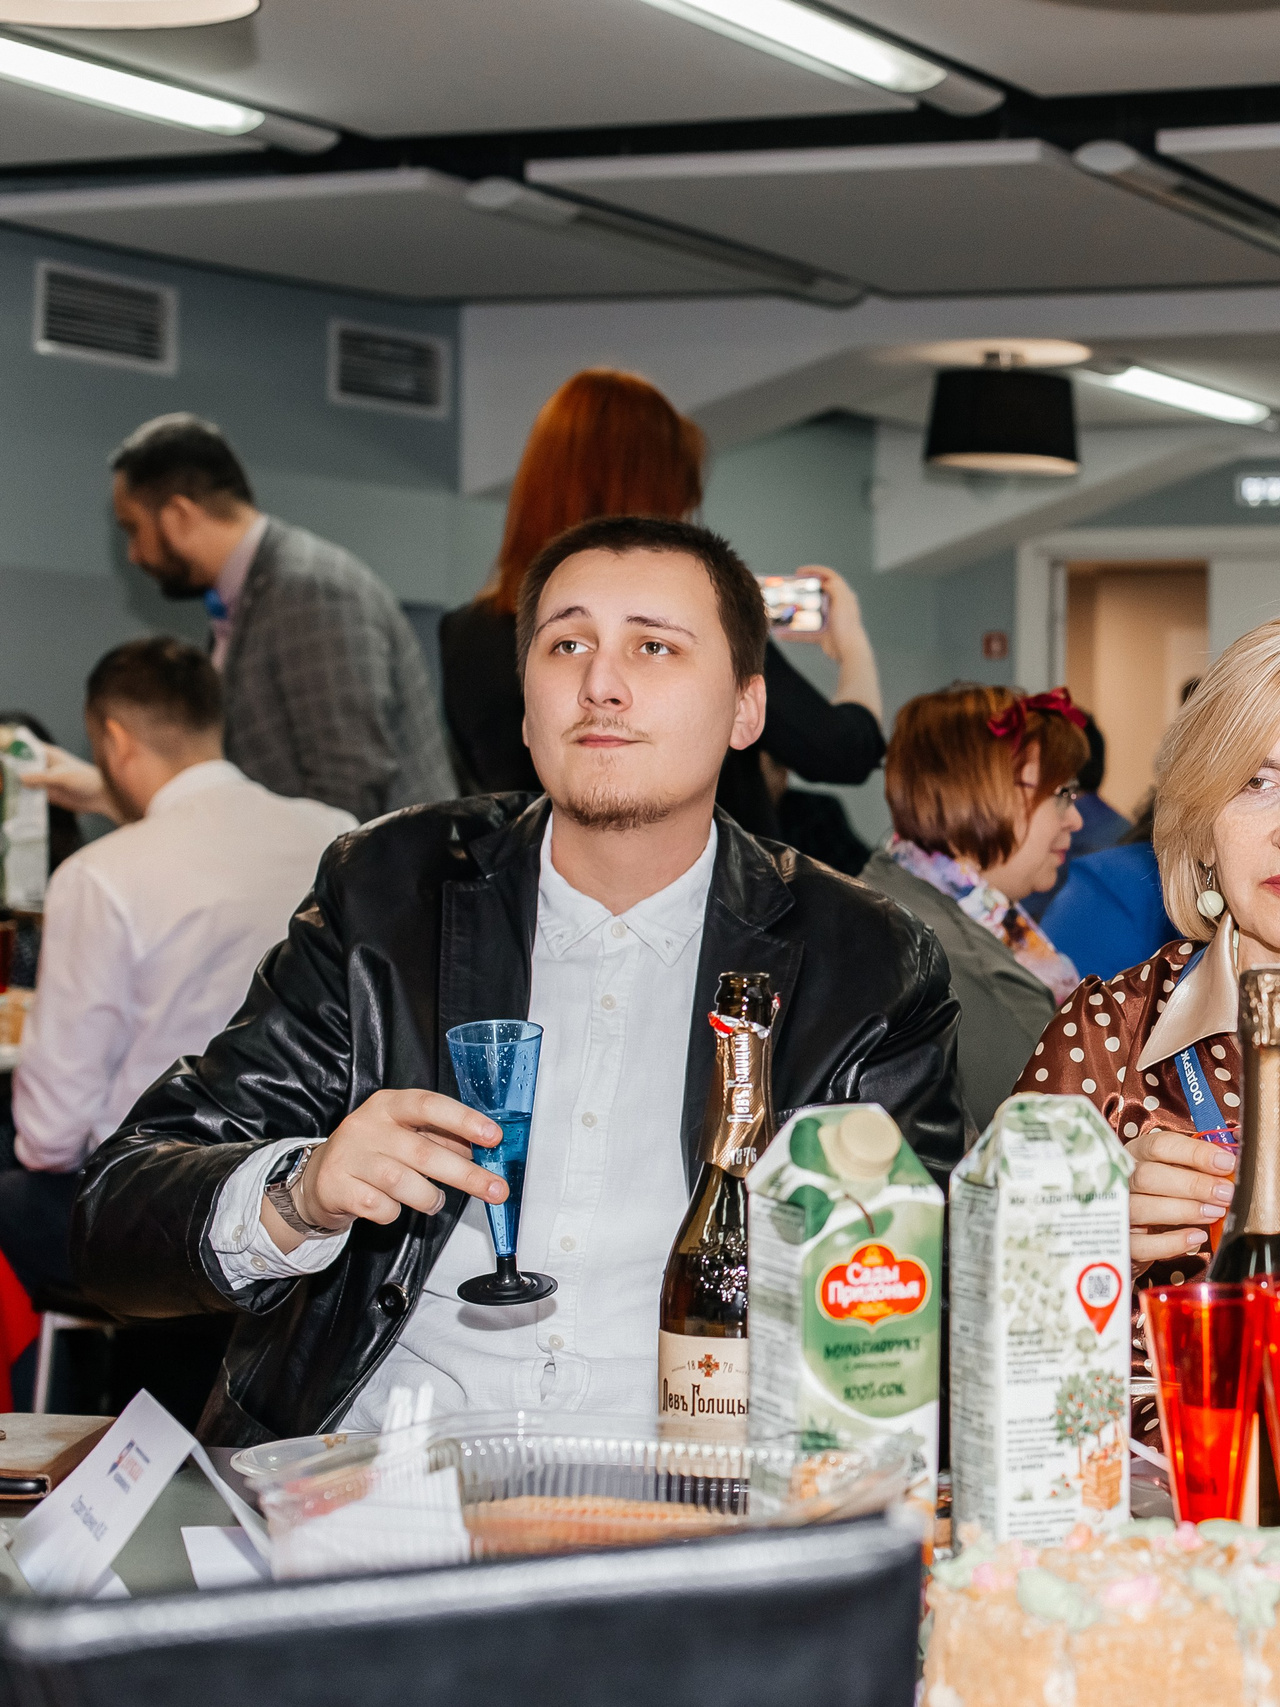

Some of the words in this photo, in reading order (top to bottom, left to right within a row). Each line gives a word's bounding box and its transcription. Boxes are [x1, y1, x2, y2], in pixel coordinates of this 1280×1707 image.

[729, 1146, 758, 1167] 1876
[846, 1261, 900, 1285] Сады
[828, 1280, 920, 1309] Придонья
[687, 1360, 696, 1371] 18
[722, 1361, 734, 1374] 76
[662, 1377, 689, 1413] Левъ
